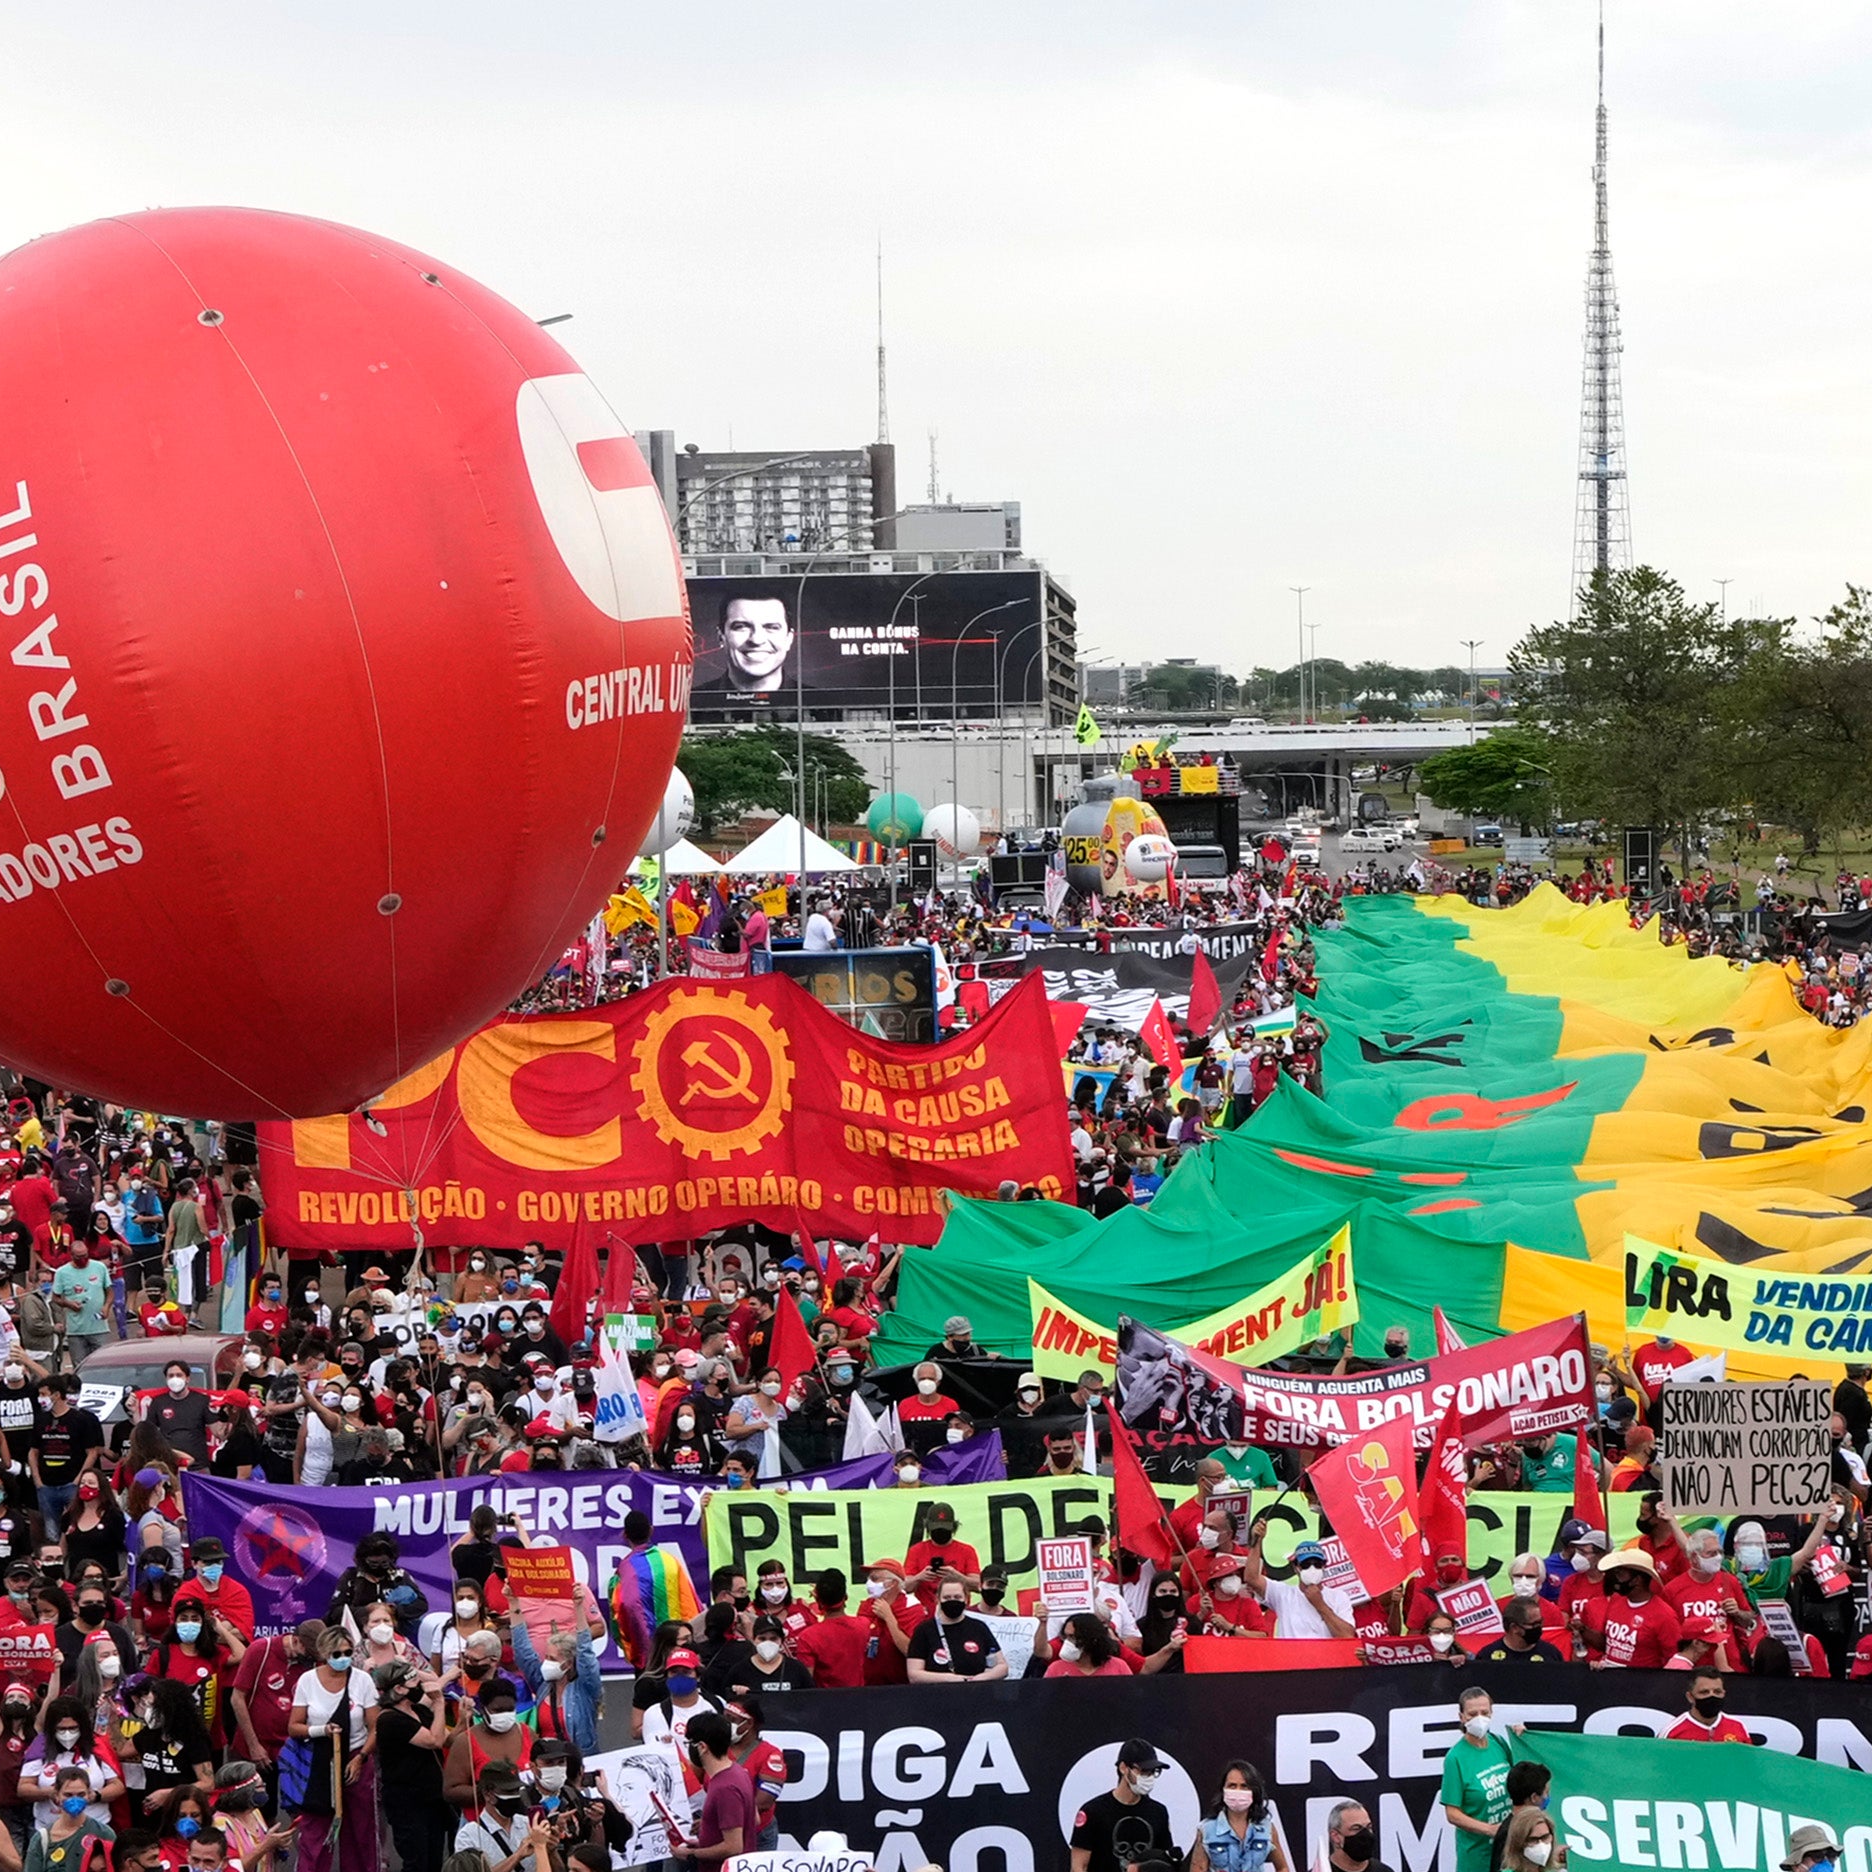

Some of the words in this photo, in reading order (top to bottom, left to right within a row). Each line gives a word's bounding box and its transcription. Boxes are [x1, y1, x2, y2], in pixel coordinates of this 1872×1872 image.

[841, 643, 859, 656] NA
[566, 664, 666, 732] CENTRAL
[847, 1042, 988, 1090] PARTIDO
[840, 1079, 887, 1116] DA
[892, 1075, 1011, 1120] CAUSA
[845, 1117, 1021, 1163] OPERÁRIA
[297, 1180, 486, 1226] REVOLUÇÃO
[517, 1183, 669, 1226] GOVERNO
[1292, 1248, 1348, 1319] JÁ!
[1624, 1250, 1734, 1327] LIRA
[1743, 1310, 1795, 1349] DA
[1243, 1382, 1347, 1431] FORA
[1355, 1347, 1588, 1432] BOLSONARO
[1245, 1370, 1313, 1396] NINGUÉM
[1316, 1375, 1384, 1396] AGUENTA
[1386, 1365, 1427, 1390] MAIS
[0, 1397, 33, 1416] FORA
[1512, 1413, 1537, 1435] AÇÃO
[1537, 1408, 1570, 1431] PETISTA
[1663, 1387, 1748, 1426] SERVIDORES
[1750, 1386, 1831, 1426] ESTÁVEIS
[1264, 1418, 1319, 1447] SEUS
[1664, 1427, 1743, 1463] DENUNCIAM
[1748, 1424, 1831, 1461] CORRUPÇÃO
[1669, 1462, 1716, 1507] NÃO
[1046, 1545, 1085, 1570] FORA
[1452, 1589, 1481, 1613] NÃO
[1365, 1641, 1431, 1661] FORA
[778, 1720, 1030, 1803] DIGA
